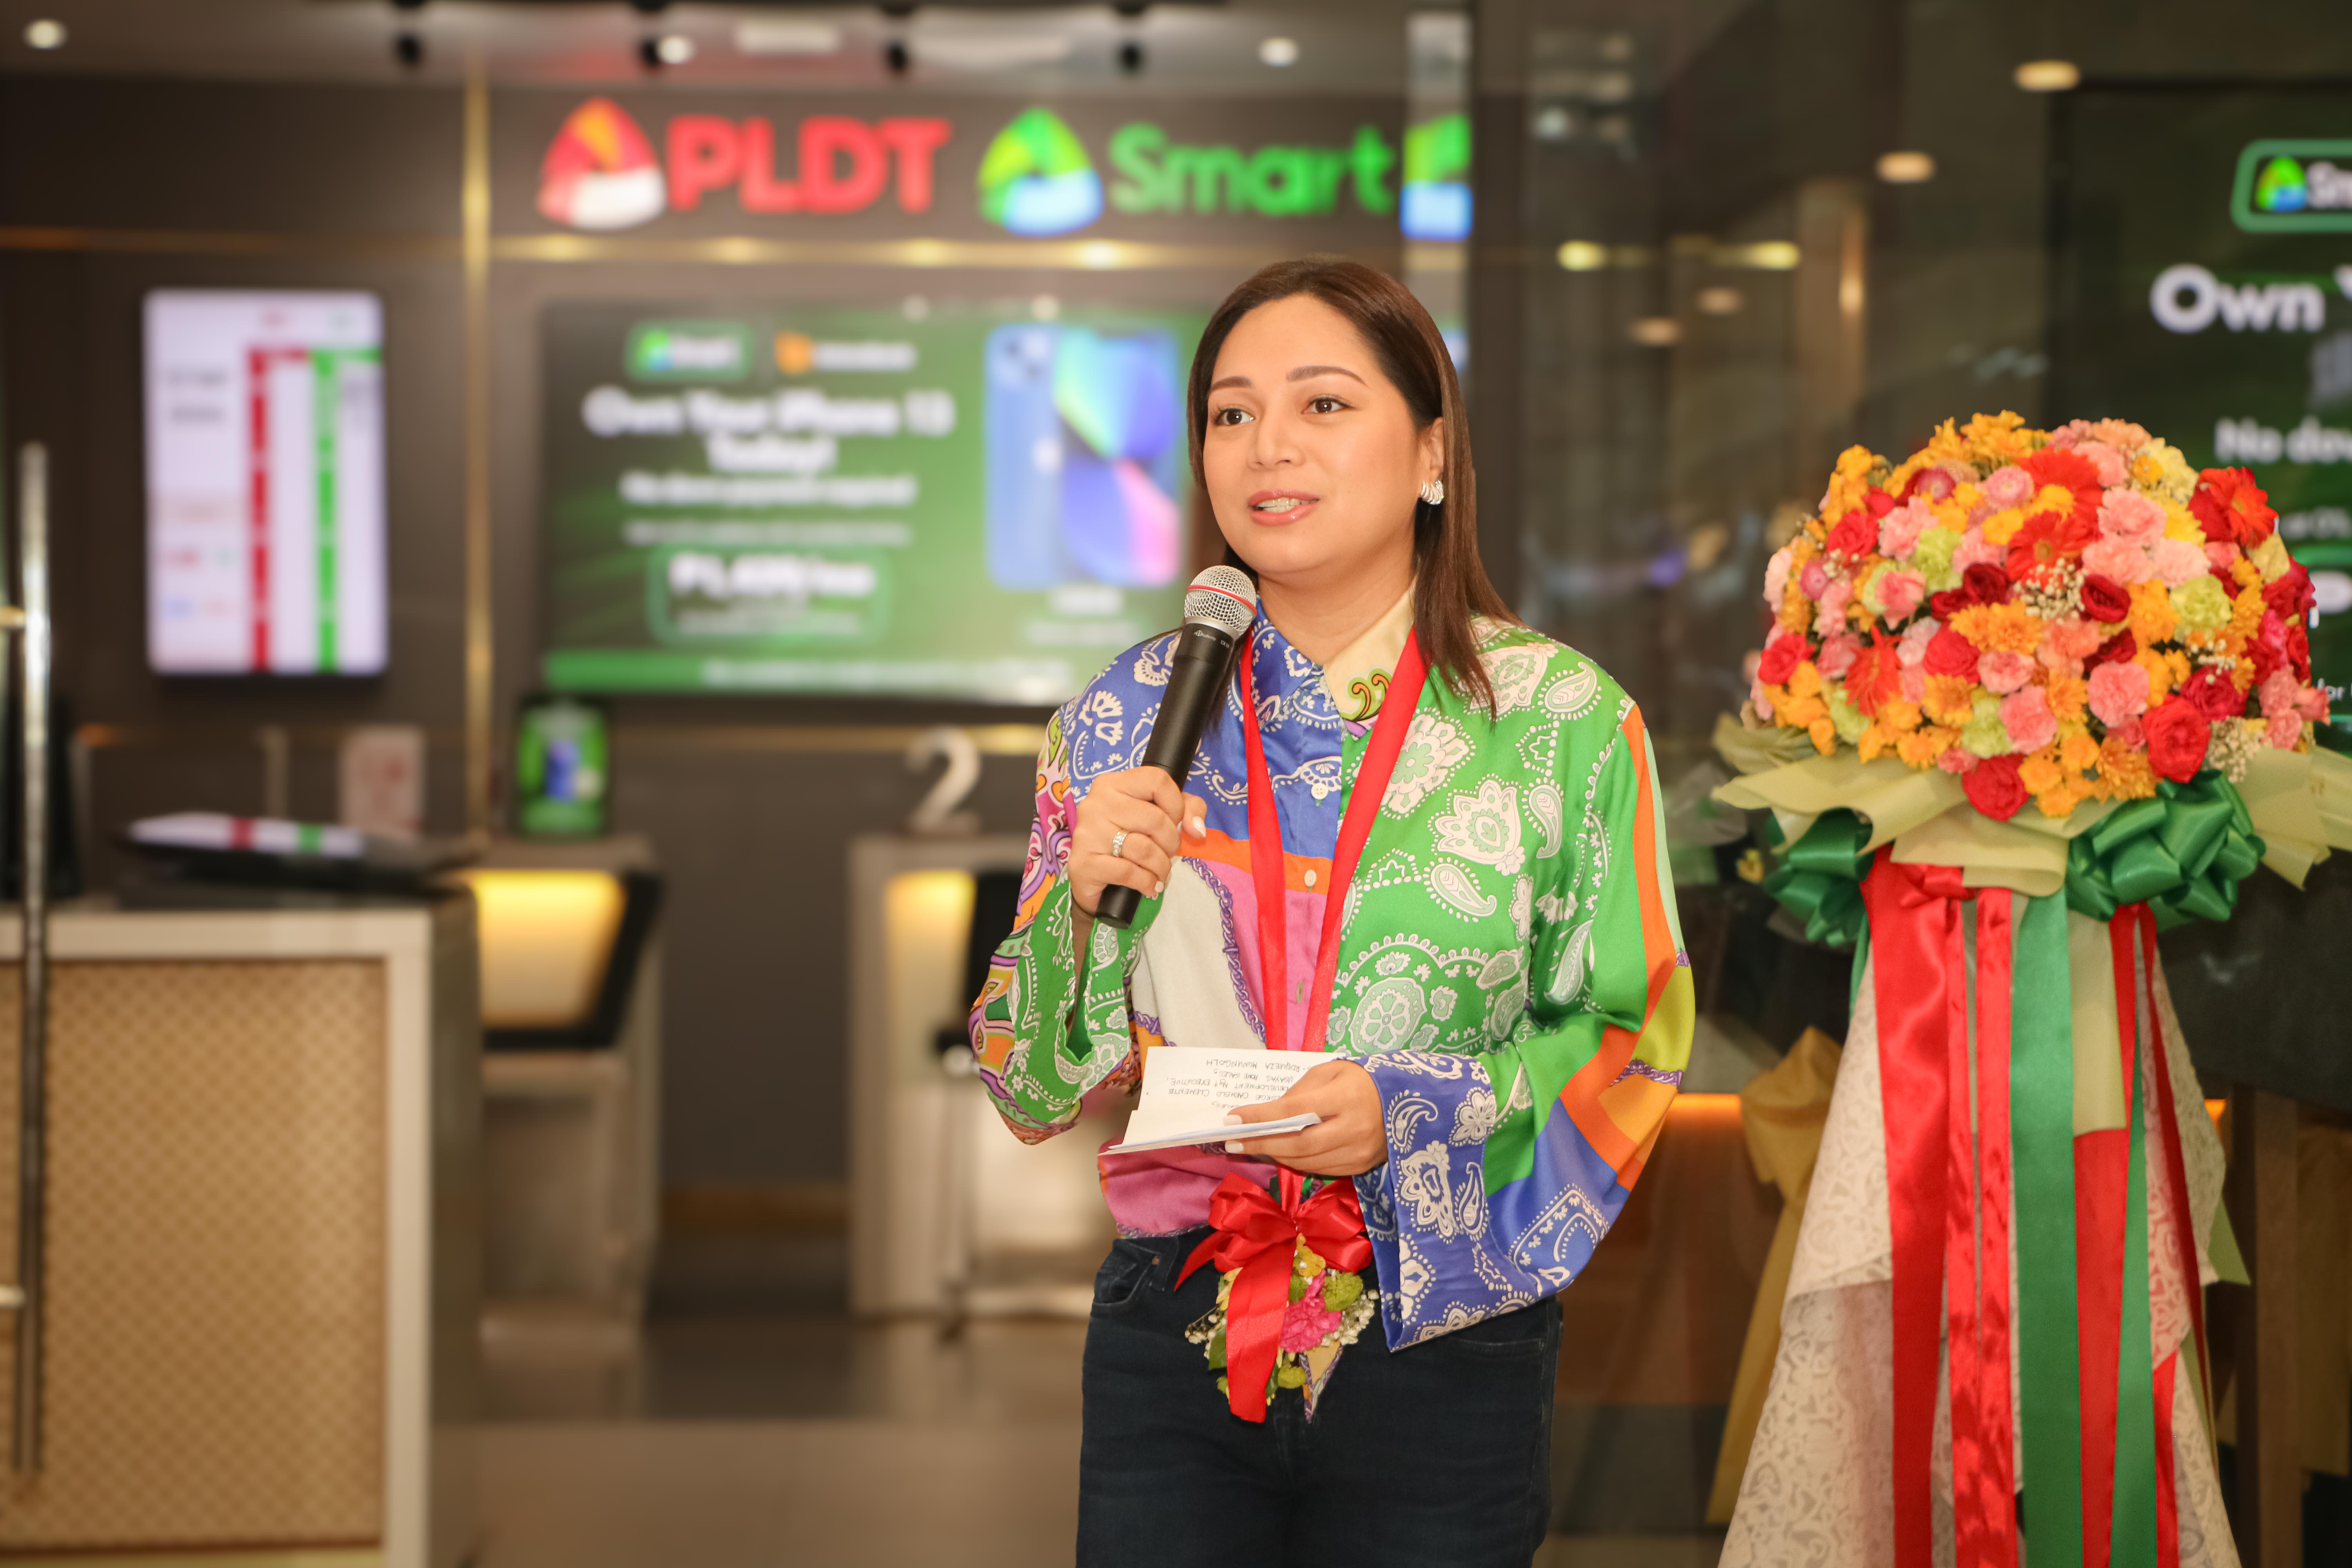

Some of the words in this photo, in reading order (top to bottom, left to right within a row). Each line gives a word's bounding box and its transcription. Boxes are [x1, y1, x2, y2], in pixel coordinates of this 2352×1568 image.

[667, 114, 952, 214] PLDT
[1110, 123, 1392, 215] Smart
[2151, 264, 2325, 332] Own
[2216, 417, 2283, 463] No
[906, 724, 980, 829] 2
[1168, 1088, 1209, 1097] CLEMENTE
